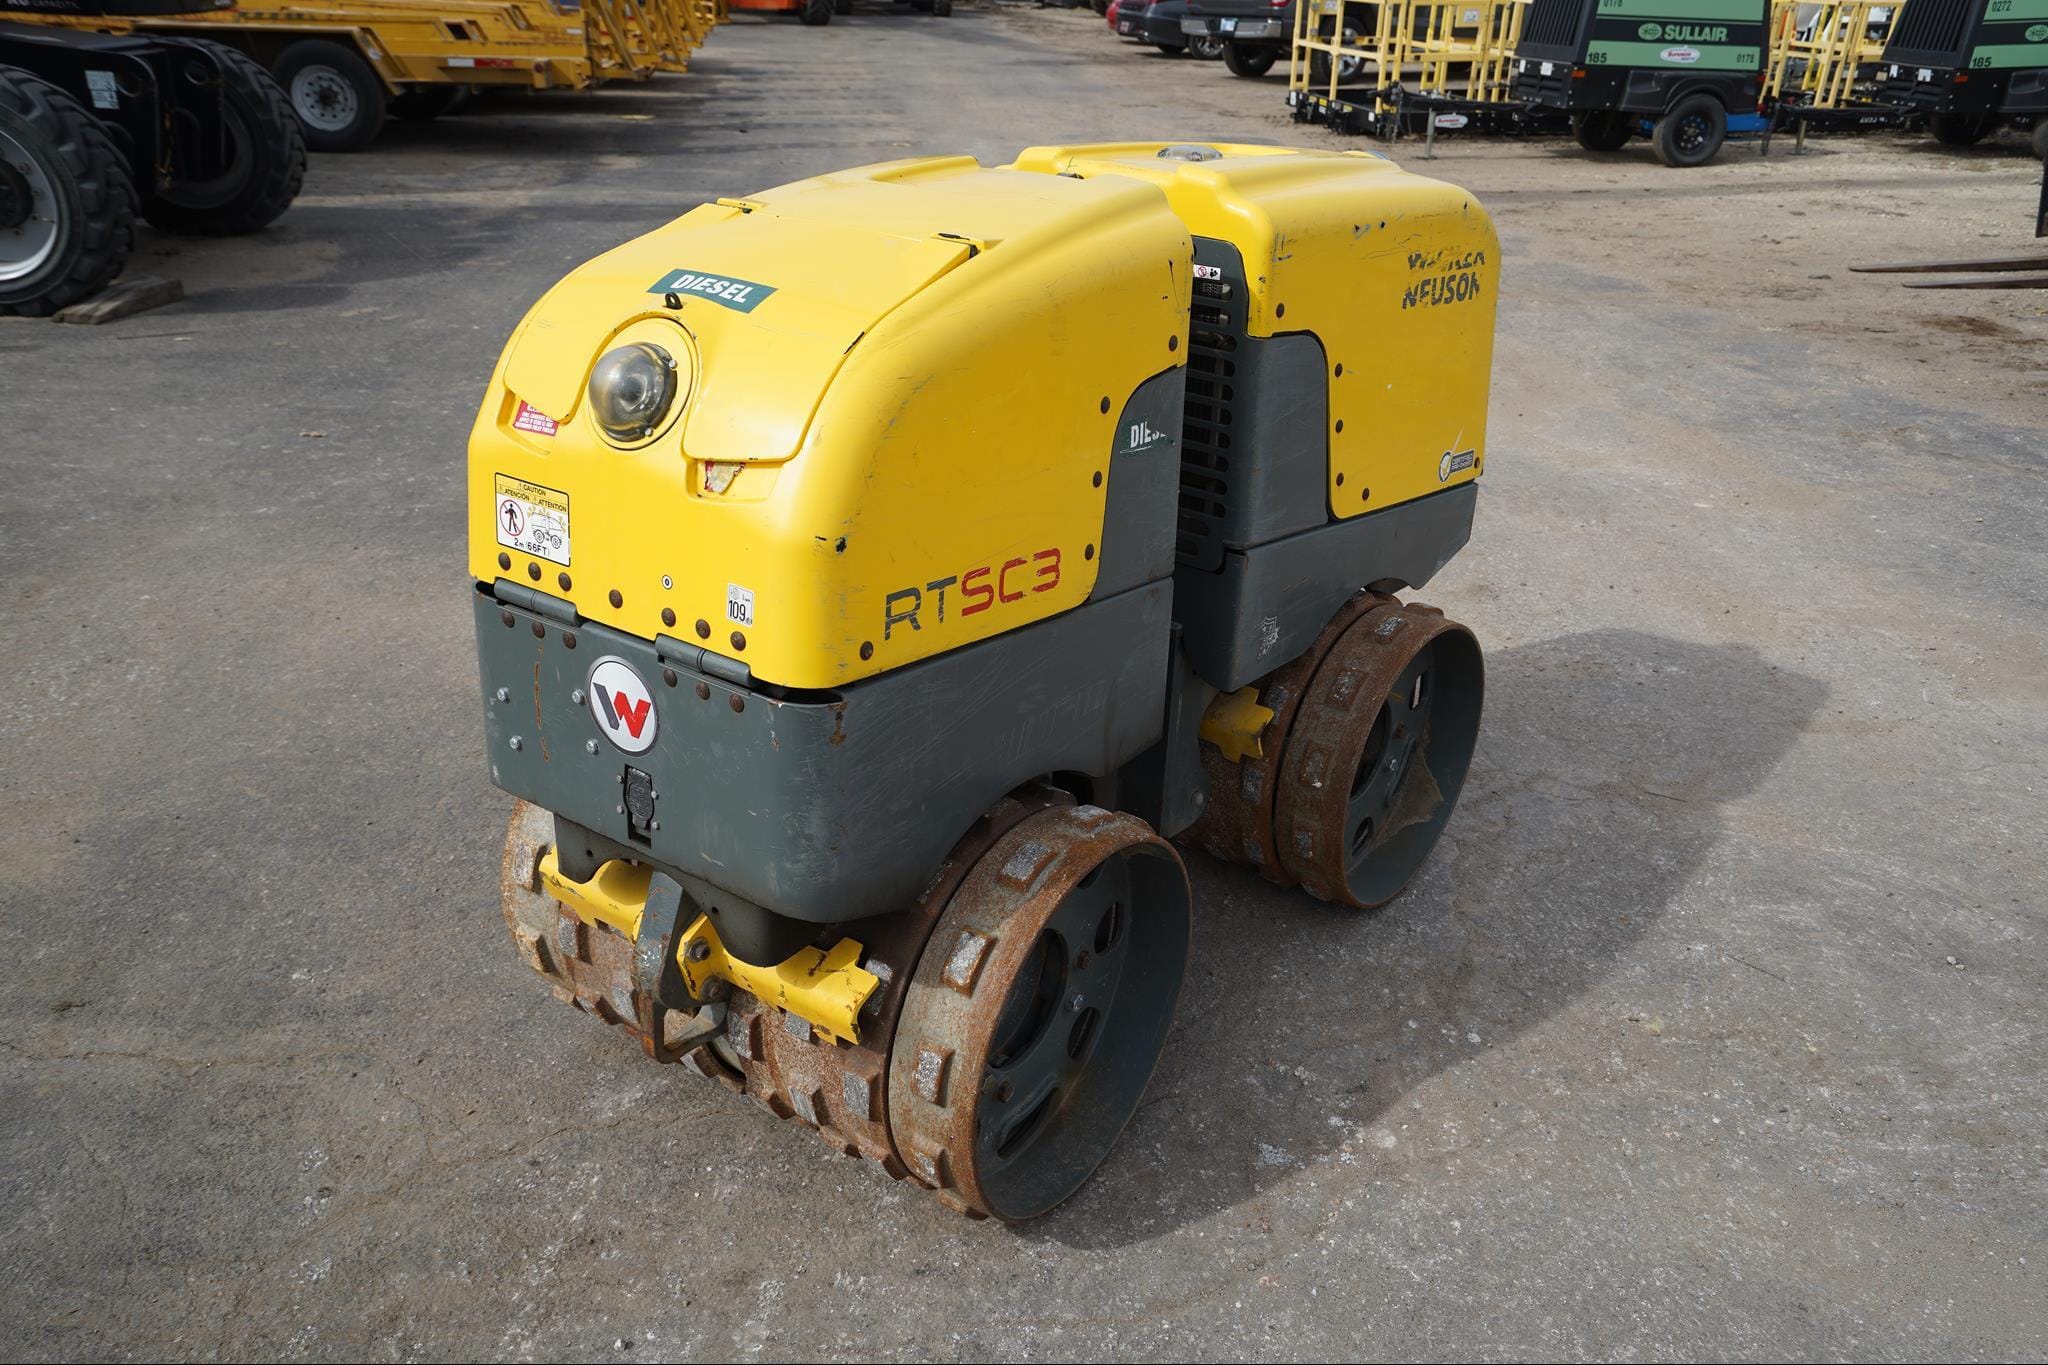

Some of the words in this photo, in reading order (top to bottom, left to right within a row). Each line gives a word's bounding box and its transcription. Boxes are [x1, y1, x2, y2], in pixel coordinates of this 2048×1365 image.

[1992, 1, 2012, 12] 0272
[1664, 25, 1728, 42] SULLAIR
[1588, 52, 1608, 64] 185
[1736, 53, 1755, 64] 0178
[1972, 57, 1992, 68] 185
[670, 274, 755, 304] DIESEL
[523, 484, 546, 497] CAUTION
[538, 498, 566, 513] ATTENTION
[728, 600, 746, 622] 109
